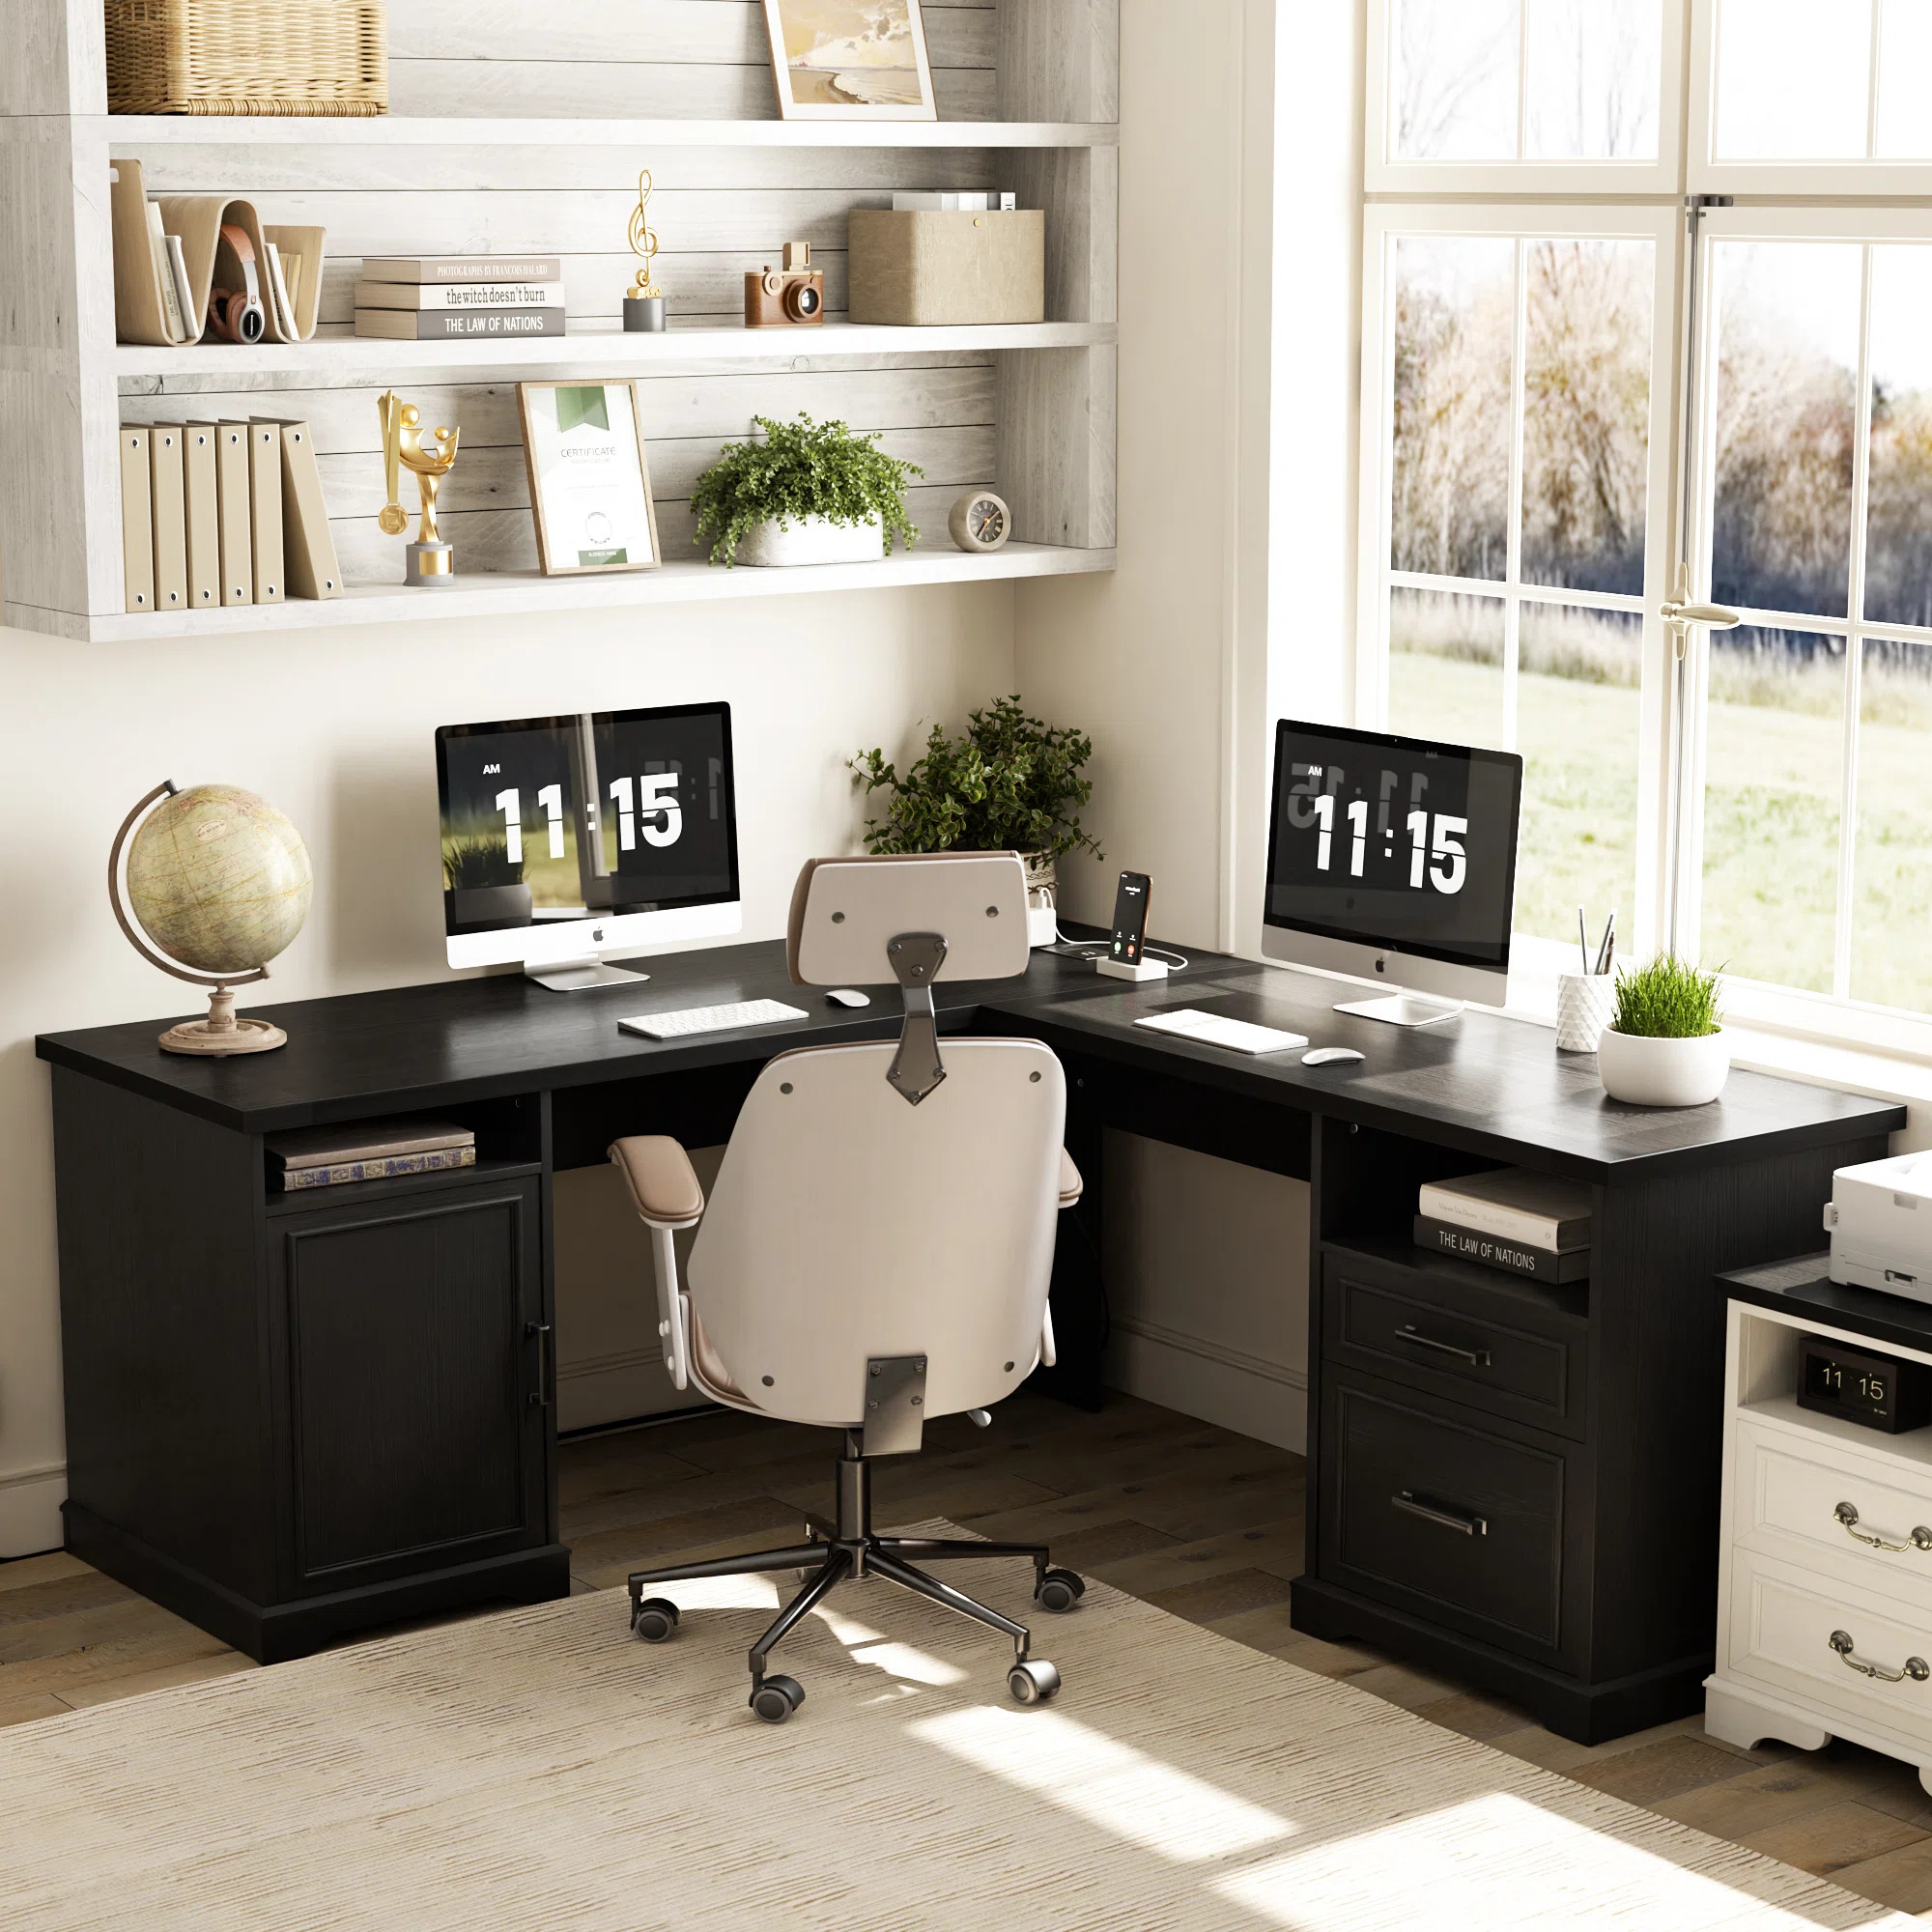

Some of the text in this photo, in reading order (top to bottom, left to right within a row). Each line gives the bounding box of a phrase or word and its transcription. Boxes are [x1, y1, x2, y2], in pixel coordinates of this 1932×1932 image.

[438, 266, 484, 277] PHOTOGRAPHS
[485, 265, 492, 275] BY
[446, 289, 462, 304] the
[463, 288, 488, 304] witch
[524, 287, 546, 301] burn
[445, 316, 544, 332] THE LAW OF NATIONS
[560, 446, 616, 458] CERTIFICATE
[483, 763, 500, 775] AM
[1308, 765, 1322, 777] AM
[1439, 1231, 1535, 1271] THE LAW OF NATIONS
[1859, 1378, 1884, 1400] 15
